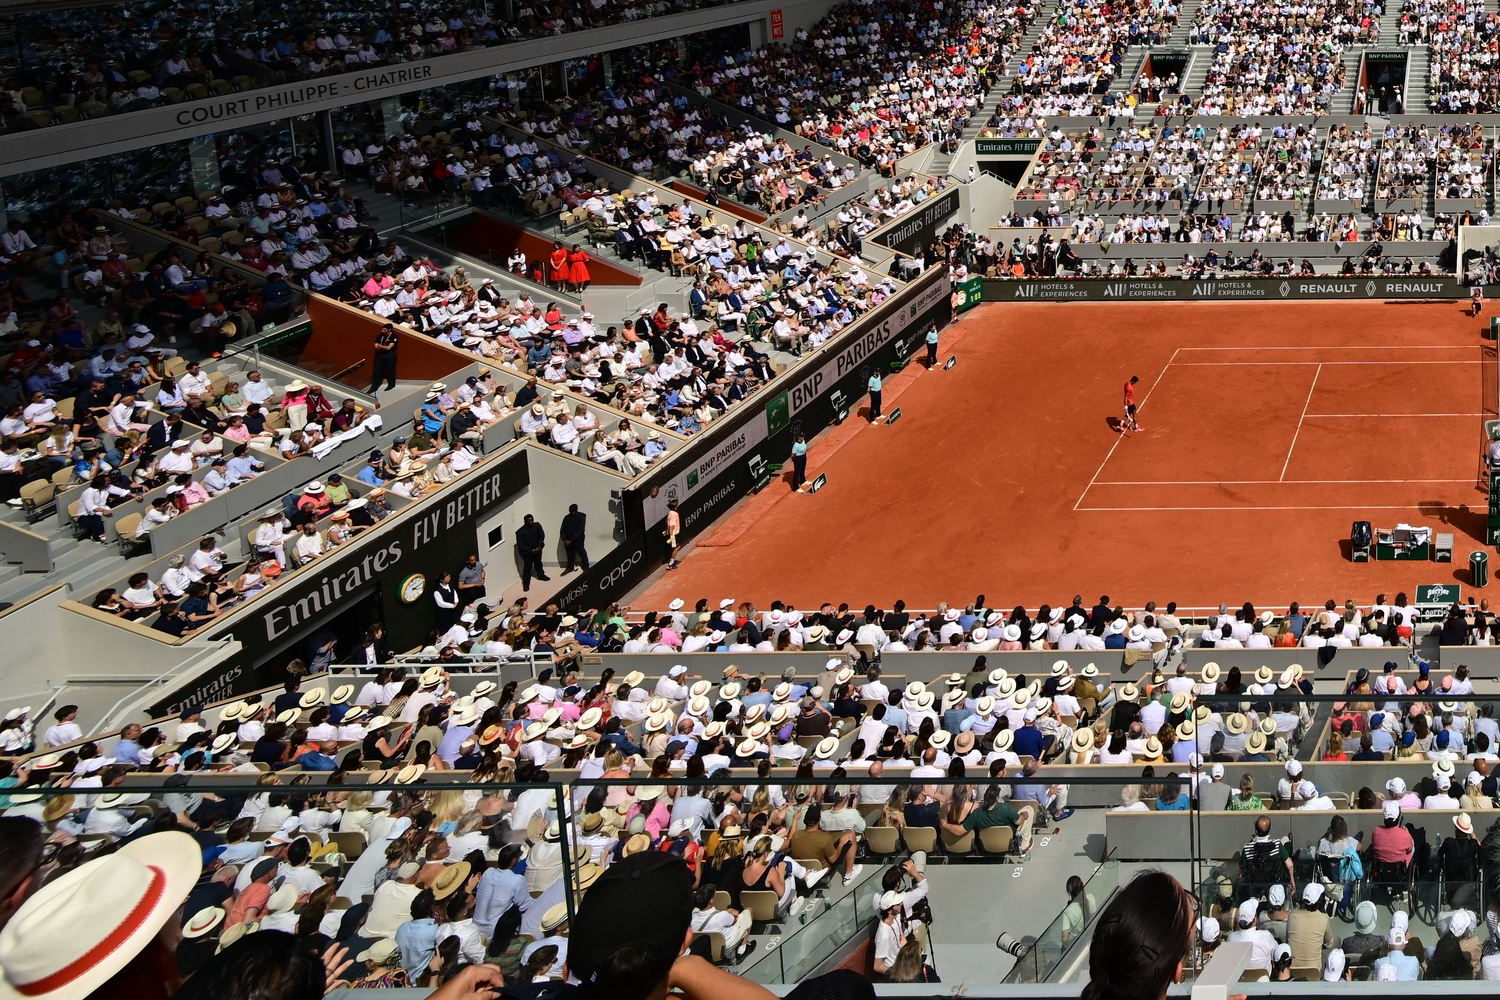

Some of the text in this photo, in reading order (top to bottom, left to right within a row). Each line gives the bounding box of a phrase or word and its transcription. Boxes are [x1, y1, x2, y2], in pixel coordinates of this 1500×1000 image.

[176, 98, 249, 126] COURT
[255, 82, 339, 111] PHILIPPE
[353, 65, 433, 91] CHATRIER
[977, 143, 1039, 152] Emirates FLY BETTE
[886, 197, 952, 248] Emirates FLY BETTER
[1040, 290, 1088, 298] EXPERIENCES
[1300, 284, 1358, 294] RENAULT
[1385, 283, 1444, 293] RENAULT
[792, 371, 823, 412] BNP
[836, 320, 891, 377] PARIBAS
[700, 433, 746, 475] BNP PARIBAS
[685, 480, 736, 528] BNP PARIBAS
[263, 473, 501, 642] Emirates FLY BETTER
[599, 550, 642, 590] oppo
[560, 580, 589, 609] Infosys
[166, 664, 242, 716] Emirates
[1039, 836, 1051, 847] 02
[1012, 866, 1024, 878] 03
[765, 935, 781, 950] 05
